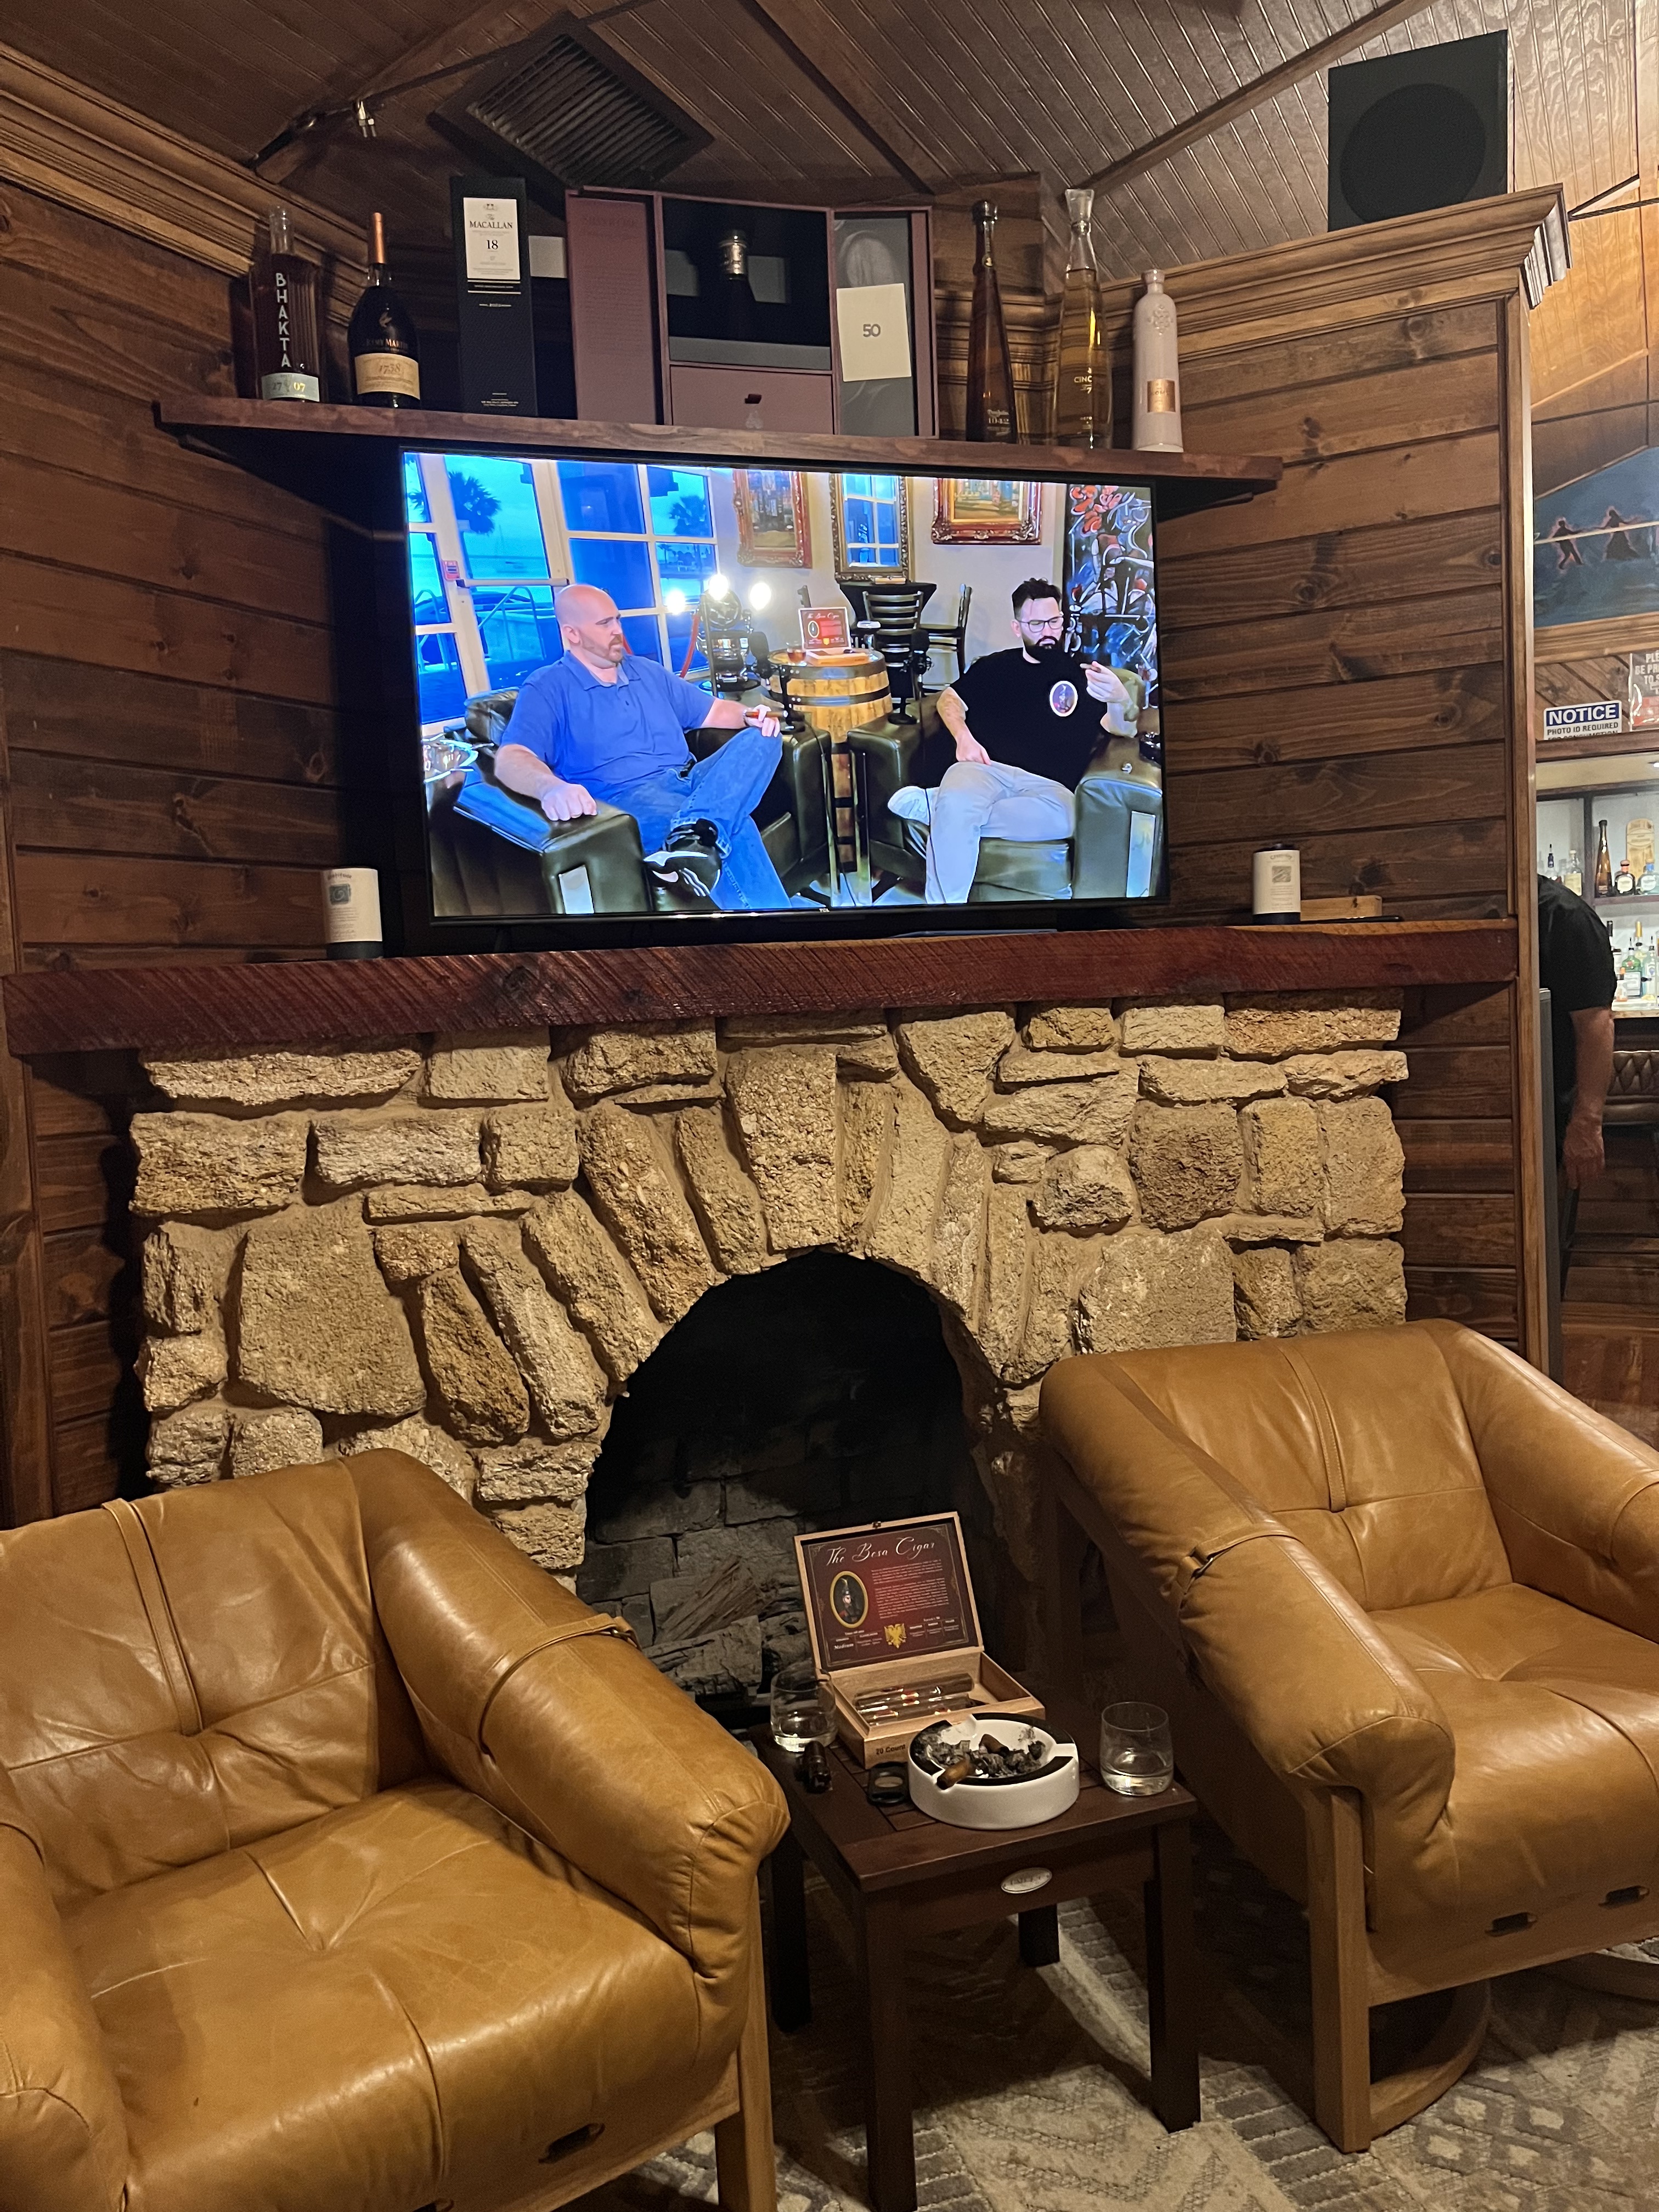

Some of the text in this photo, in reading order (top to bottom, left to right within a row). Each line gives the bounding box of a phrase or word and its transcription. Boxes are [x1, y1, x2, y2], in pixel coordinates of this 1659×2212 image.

[470, 221, 513, 229] MACALLAN
[487, 240, 498, 250] 18
[276, 273, 292, 368] BHAKTA
[863, 324, 881, 337] 50
[379, 363, 400, 375] 1738
[294, 382, 306, 392] 07
[1635, 664, 1646, 675] BE
[1549, 704, 1616, 725] NOTICE
[1547, 727, 1571, 736] PHOTO
[1582, 722, 1618, 731] REQUIRED
[827, 1546, 847, 1566] The
[896, 1537, 935, 1560] Cigar
[885, 1744, 906, 1753] Count
